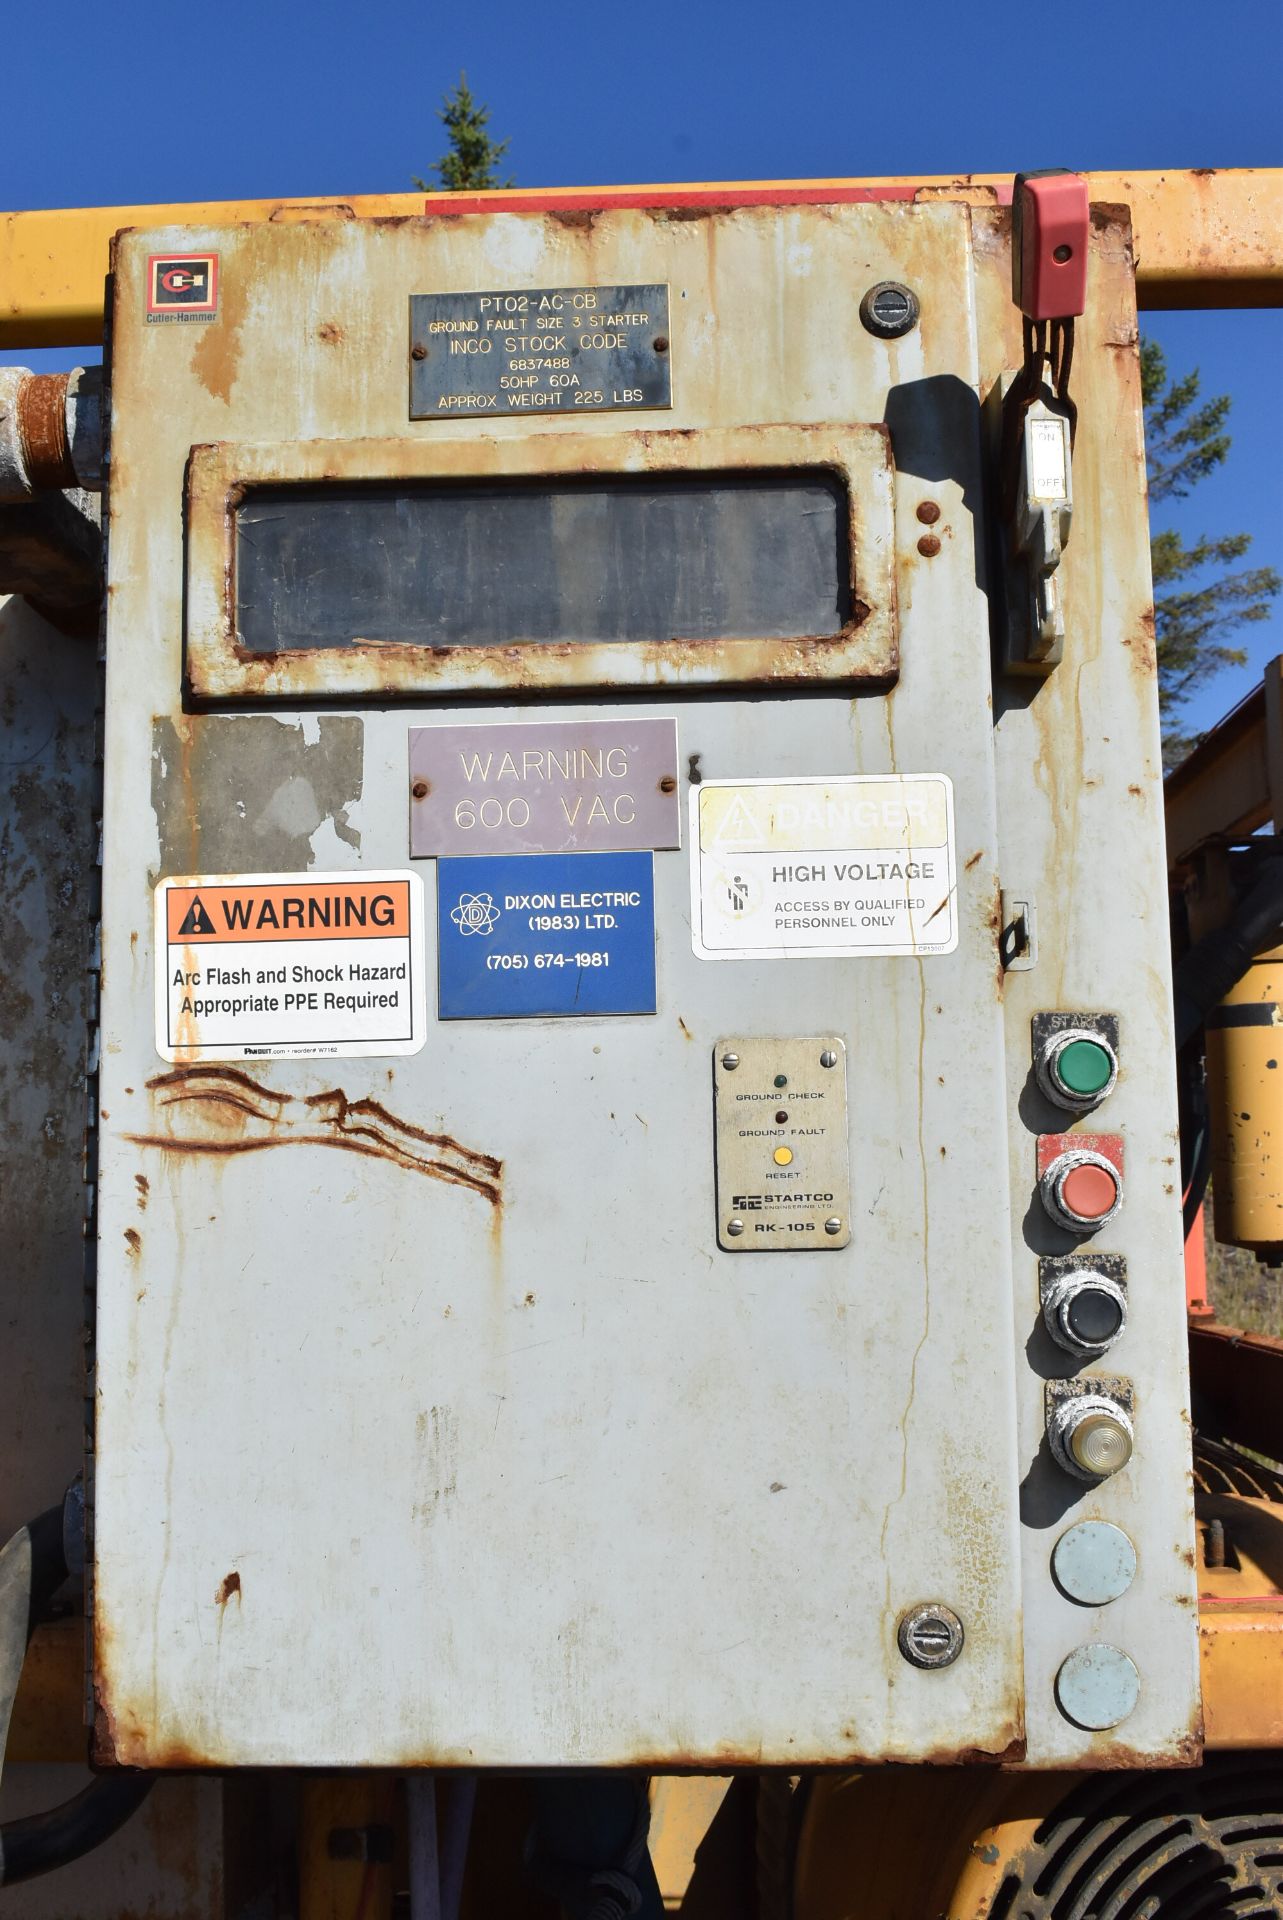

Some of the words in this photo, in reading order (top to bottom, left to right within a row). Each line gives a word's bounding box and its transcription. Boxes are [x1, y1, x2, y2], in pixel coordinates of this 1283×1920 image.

[429, 321, 479, 334] GROUND
[486, 318, 528, 331] FAULT
[536, 317, 563, 329] SIZE
[572, 316, 581, 328] 3
[590, 314, 649, 327] STARTER
[450, 338, 492, 355] INCO
[505, 335, 566, 352] STOCK
[580, 333, 629, 350] CODE
[509, 358, 570, 370] 6837488
[499, 375, 539, 389] 50HP
[549, 374, 580, 387] 60A
[438, 395, 497, 409] APPROX
[508, 392, 562, 407] WEIGHT
[574, 391, 603, 405] 225
[614, 389, 643, 403] LBS
[1038, 433, 1055, 441] ON
[1037, 478, 1059, 486] OFF
[460, 748, 628, 782] WARNING
[455, 797, 530, 829] 600
[560, 794, 636, 827] VAC
[776, 800, 928, 830] DANGER
[772, 865, 826, 883] HIGH
[833, 862, 935, 881] VOLTAGE
[504, 894, 556, 910] DIXON
[560, 892, 640, 908] ELECTRIC
[774, 901, 830, 913] ACCESS
[834, 900, 850, 911] BY
[854, 898, 926, 911] QUALIFIED
[221, 895, 395, 931] WARNING
[528, 915, 580, 931] (1983)
[585, 914, 619, 930] LTD.
[775, 917, 857, 929] PERSONNEL
[861, 916, 895, 928] ONLY
[486, 955, 529, 970] (705)
[534, 952, 609, 969] 674-1981
[173, 969, 201, 986] Arc
[206, 967, 251, 985] Flash
[256, 966, 287, 984] and
[291, 965, 344, 983] Shock
[349, 962, 406, 981] Hazard
[181, 994, 279, 1017] Appropriate
[284, 993, 318, 1010] PPE
[324, 991, 399, 1013] Required
[1051, 1016, 1098, 1028] START
[764, 1193, 834, 1203] STARTCO
[754, 1223, 816, 1233] RK-105
